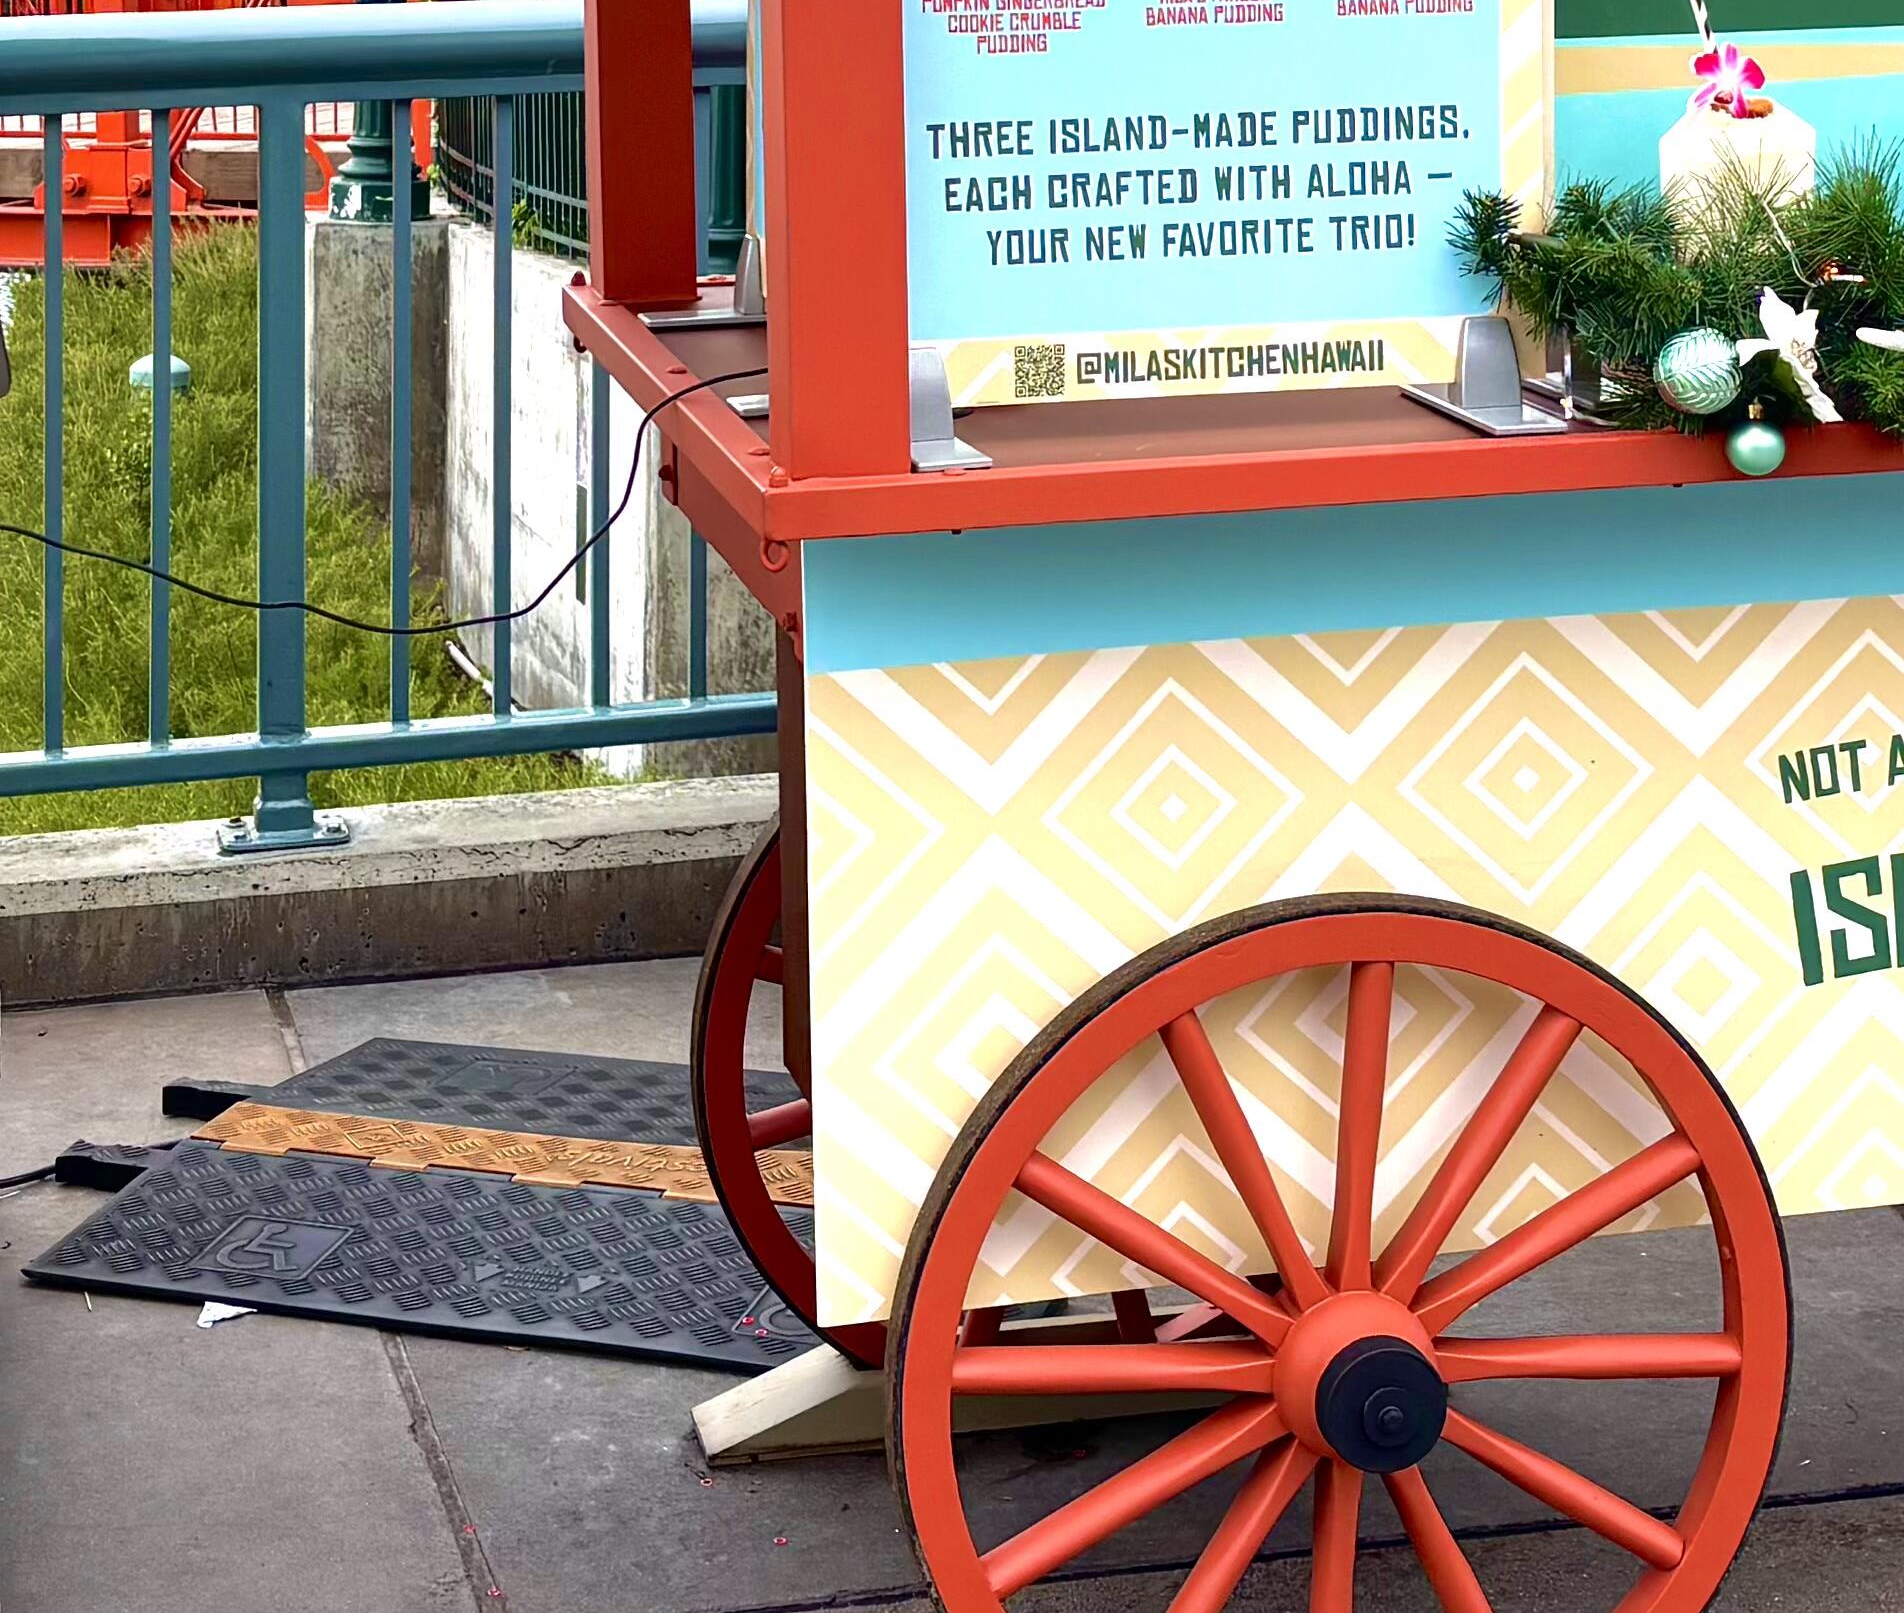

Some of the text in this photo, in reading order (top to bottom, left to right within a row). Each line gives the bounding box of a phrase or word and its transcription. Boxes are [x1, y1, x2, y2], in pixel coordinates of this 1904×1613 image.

[947, 11, 1082, 35] COOKIE CRUMBLE
[1145, 3, 1285, 27] BANANA PUDDING
[976, 34, 1048, 55] PUDDING
[926, 120, 1034, 160] THREE
[1049, 111, 1278, 154] ISLAND-MADE
[945, 174, 1032, 213] EACH
[1048, 168, 1198, 210] CRAFTED
[1214, 164, 1290, 201] WITH
[1307, 160, 1412, 199] ALOHA
[986, 213, 1416, 266] YOUR NEW FAVORITE TRIO!
[1076, 340, 1384, 385] @MILASKITCHENHAWAII
[1777, 737, 1870, 805] NOT
